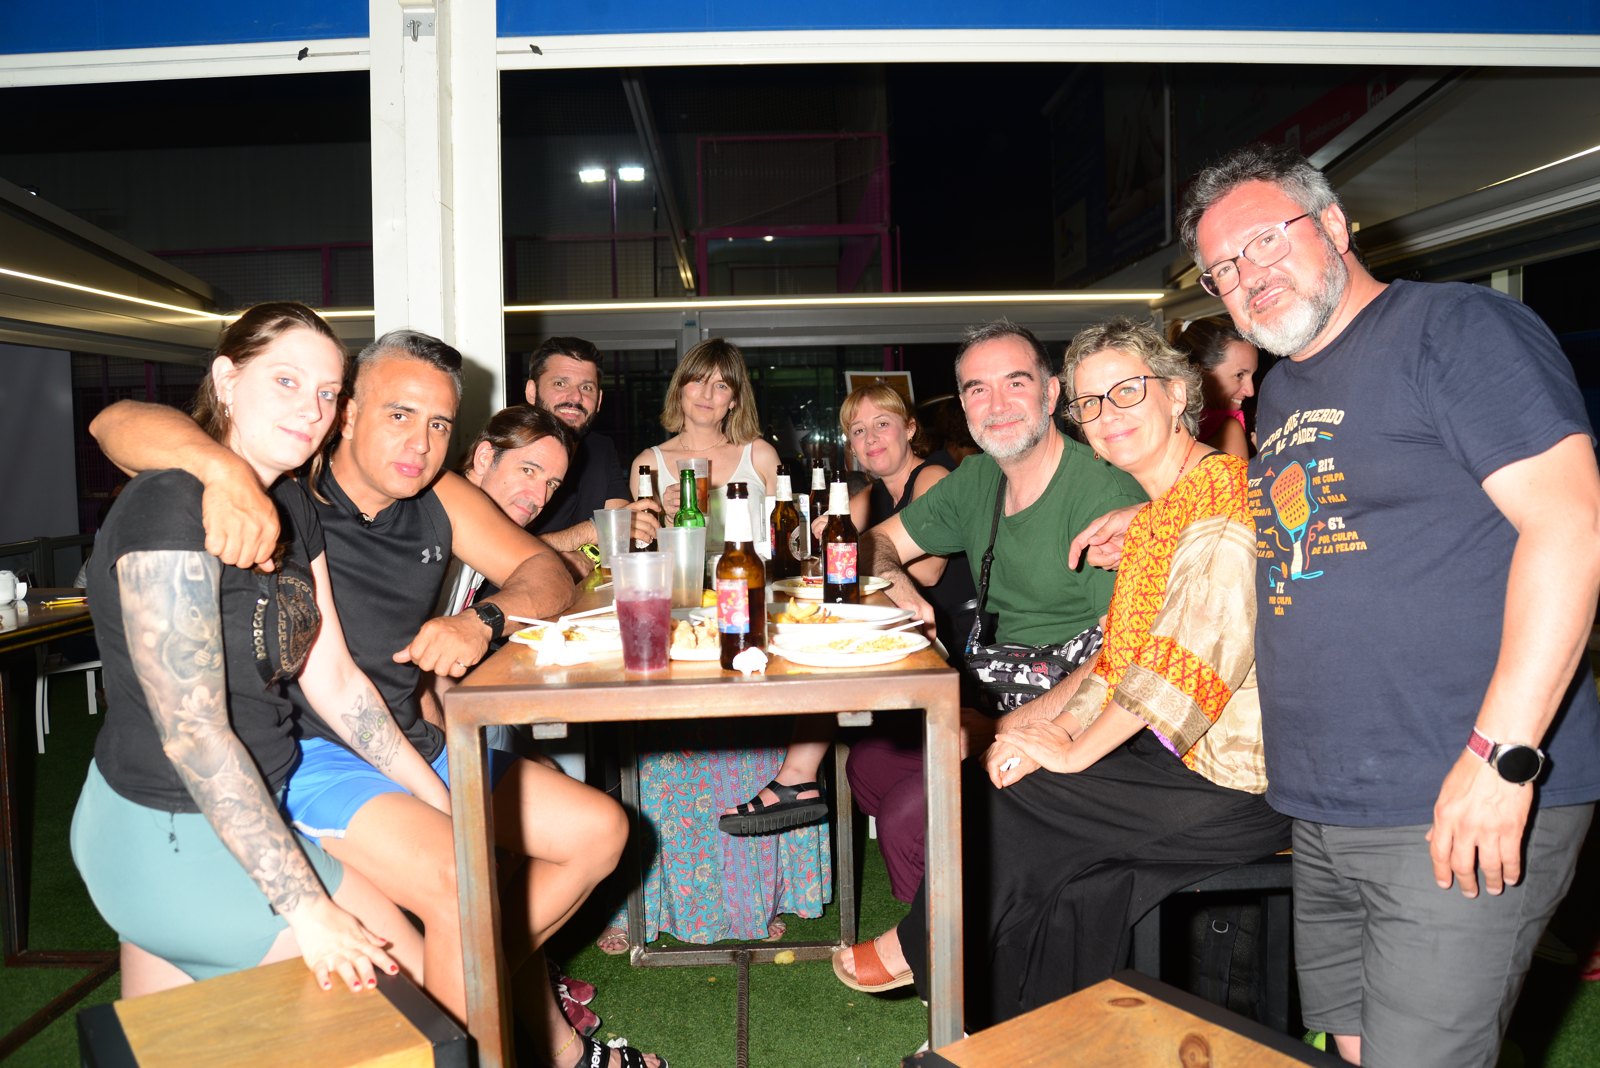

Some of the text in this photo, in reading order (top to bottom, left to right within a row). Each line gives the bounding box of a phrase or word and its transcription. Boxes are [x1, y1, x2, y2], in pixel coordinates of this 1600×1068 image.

[1260, 408, 1345, 452] POR QUÉ PIERDO
[1317, 457, 1335, 473] 21%
[1322, 472, 1345, 483] CULPA
[1327, 493, 1347, 504] PALA
[1328, 516, 1346, 531] 6%
[1318, 530, 1359, 545] POR CULPA
[1311, 541, 1368, 555] DE LA PELOTA
